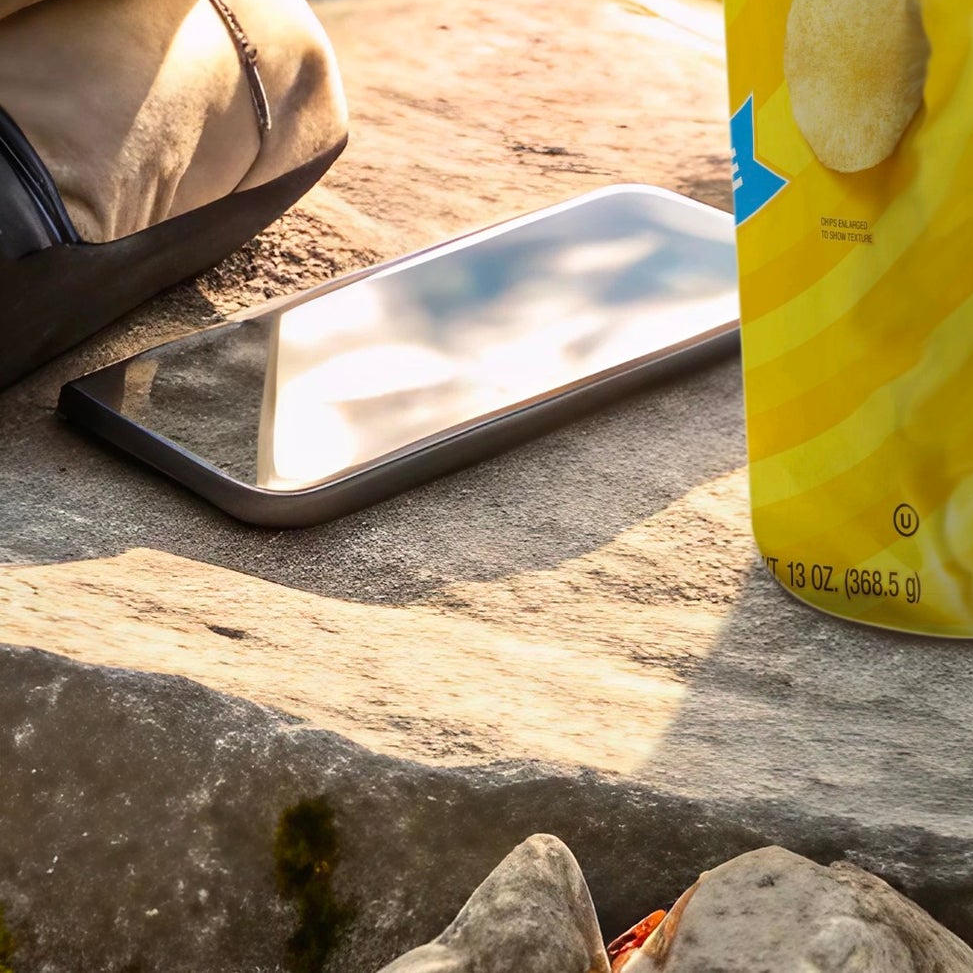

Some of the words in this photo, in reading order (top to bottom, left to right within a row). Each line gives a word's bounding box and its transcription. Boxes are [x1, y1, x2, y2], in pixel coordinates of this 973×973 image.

[821, 217, 837, 228] CHIPS
[838, 219, 868, 230] ENLARGED
[830, 230, 846, 241] SHOW
[847, 233, 873, 244] TEXTURE
[787, 561, 806, 588] 13
[811, 564, 838, 593] OZ.
[845, 568, 899, 600] (368.5
[906, 571, 921, 604] g)
